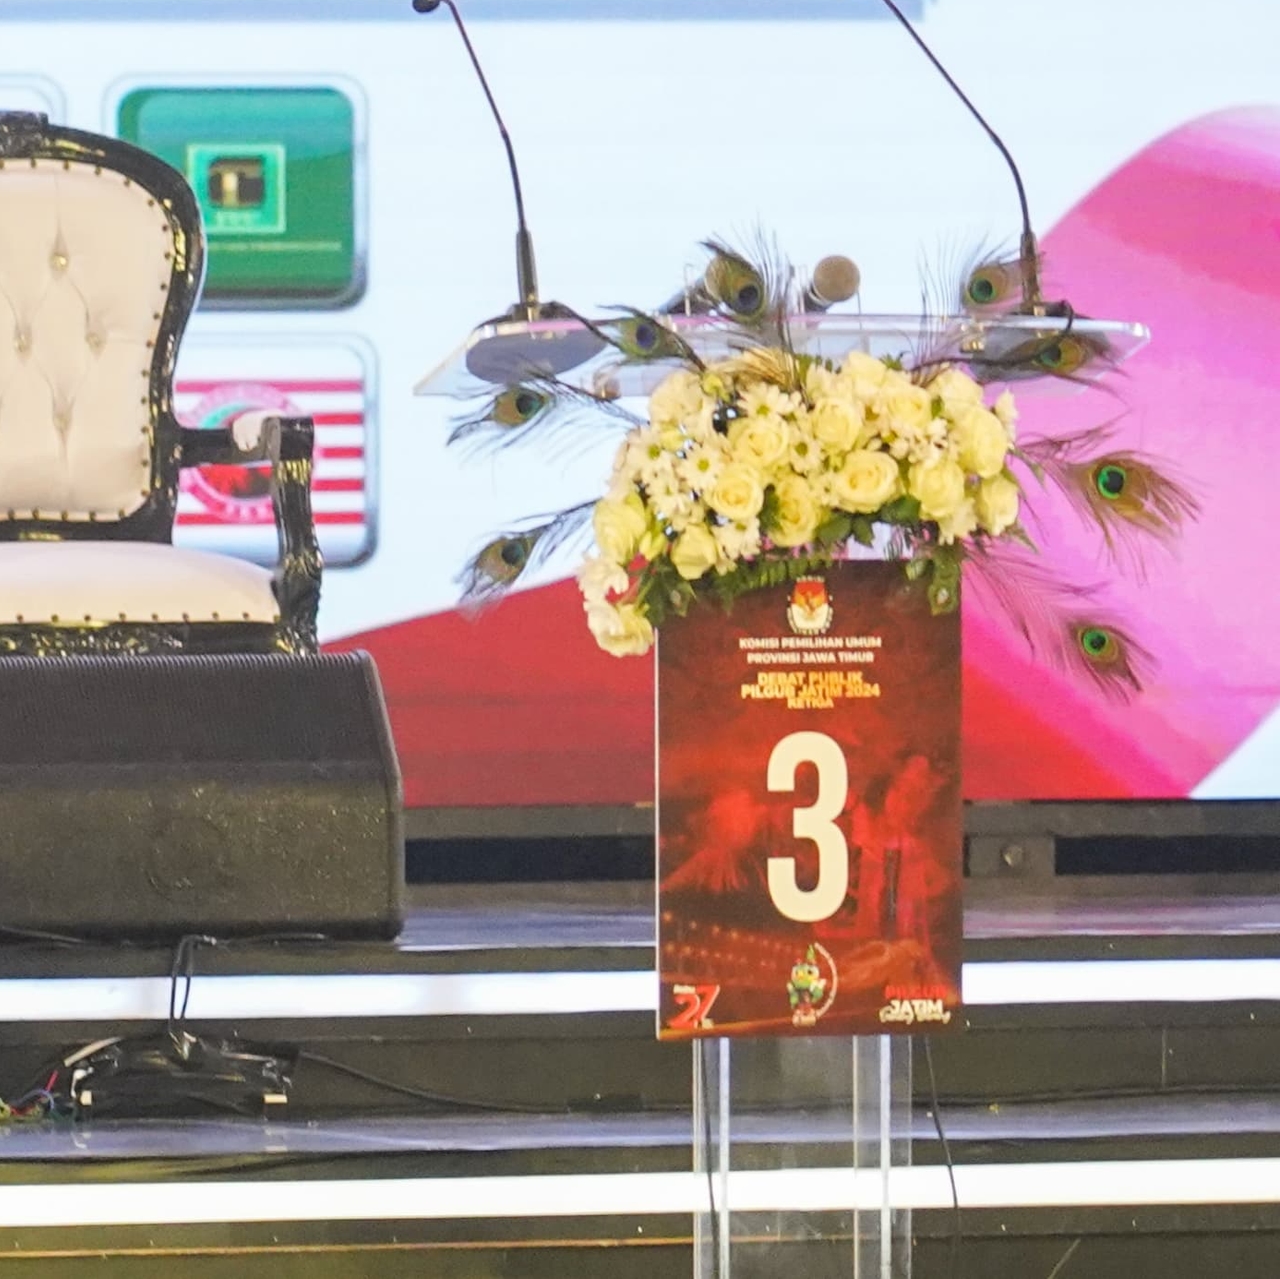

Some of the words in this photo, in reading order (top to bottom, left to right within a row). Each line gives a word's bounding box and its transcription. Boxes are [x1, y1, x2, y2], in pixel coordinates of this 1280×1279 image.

[739, 637, 779, 649] KOMISI
[781, 637, 843, 649] PEMILIHAN
[845, 637, 882, 648] UMUM
[747, 652, 801, 664] PROVINSI
[802, 652, 836, 663] JAWA
[839, 652, 874, 663] TIMUR
[758, 672, 806, 686] DEBAT
[809, 672, 863, 685] PUBLIK
[767, 730, 850, 923] 3
